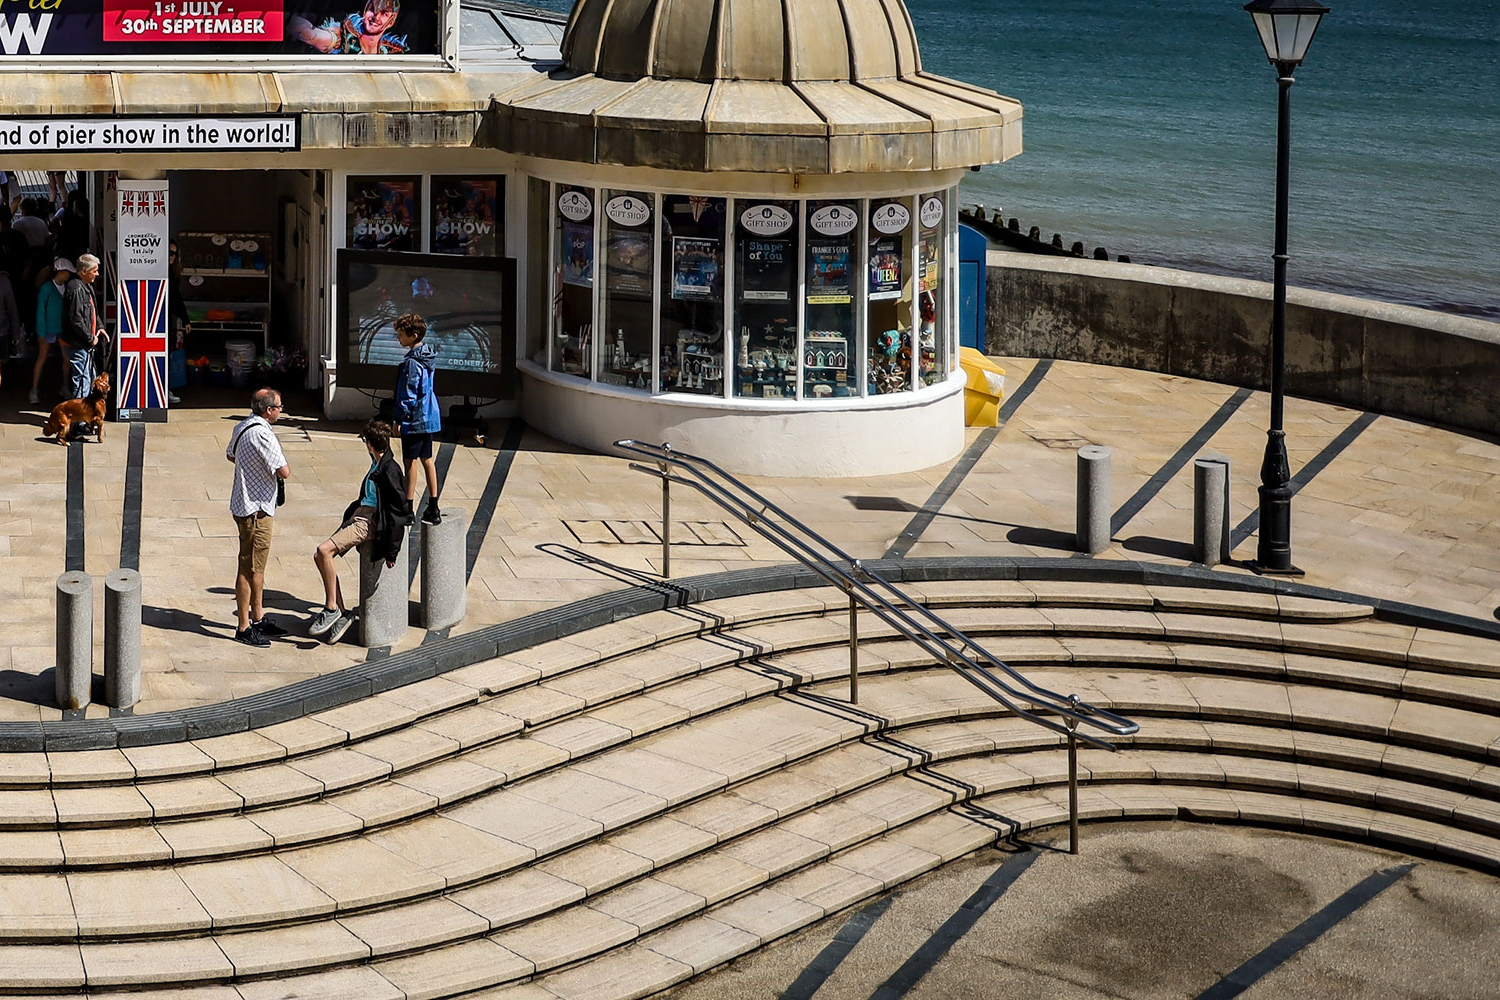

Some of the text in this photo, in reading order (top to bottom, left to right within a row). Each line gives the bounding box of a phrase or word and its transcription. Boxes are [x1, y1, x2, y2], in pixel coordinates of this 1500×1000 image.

[155, 1, 176, 16] 1st
[179, 1, 223, 16] JULY
[121, 19, 266, 34] 30th SEPTEMBER
[28, 125, 49, 144] of
[56, 125, 96, 148] pier
[102, 125, 155, 144] show
[162, 123, 180, 143] in
[187, 124, 220, 143] the
[226, 123, 291, 143] world!
[610, 210, 646, 220] GIFT SHOP
[359, 222, 409, 235] SHOW
[441, 222, 491, 234] SHOW
[766, 220, 788, 228] SHOP
[834, 220, 854, 228] SHOP
[124, 238, 162, 248] SHOW
[749, 242, 783, 252] Shape
[749, 251, 783, 260] of You
[871, 267, 899, 284] QUEENZ
